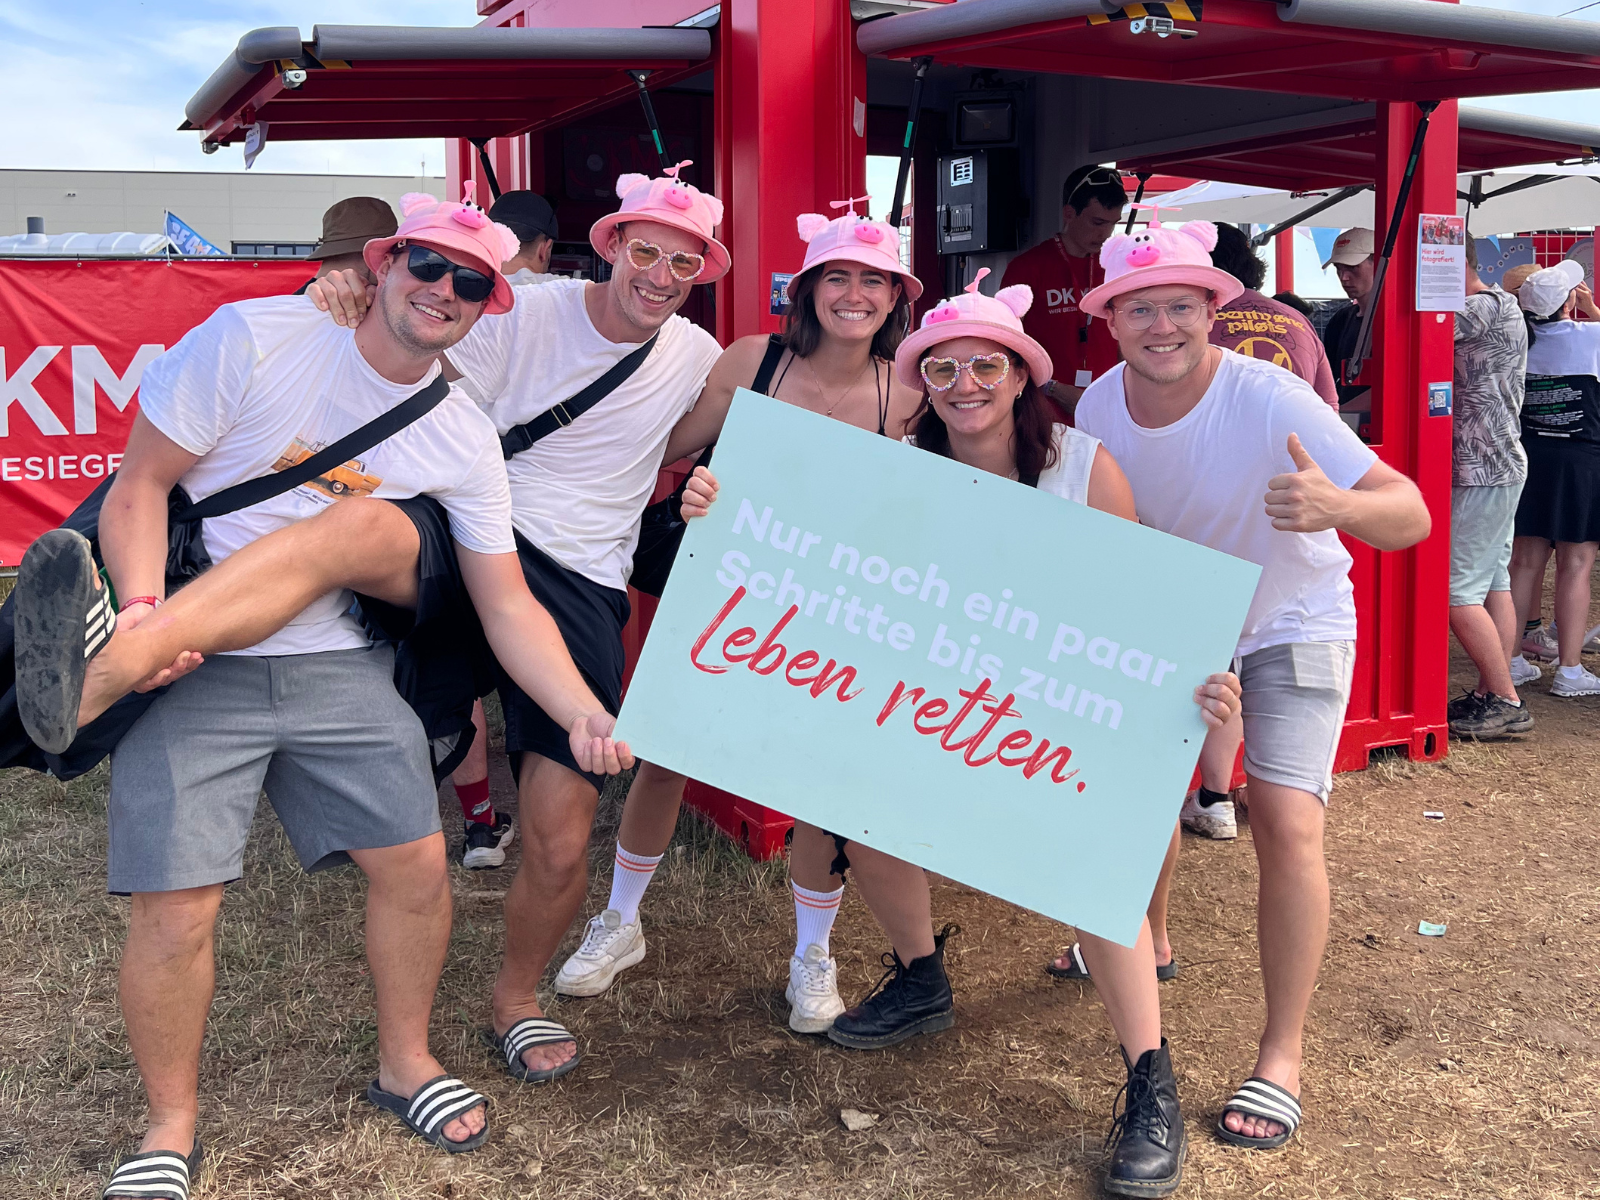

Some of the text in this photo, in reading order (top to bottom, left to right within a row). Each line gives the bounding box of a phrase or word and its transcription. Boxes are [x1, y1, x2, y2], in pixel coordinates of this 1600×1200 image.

[1421, 255, 1455, 264] fotografiert!
[716, 550, 1124, 730] Schritte bis zum
[731, 498, 1177, 687] Nur noch ein paar
[690, 585, 1086, 794] Leben retten.
